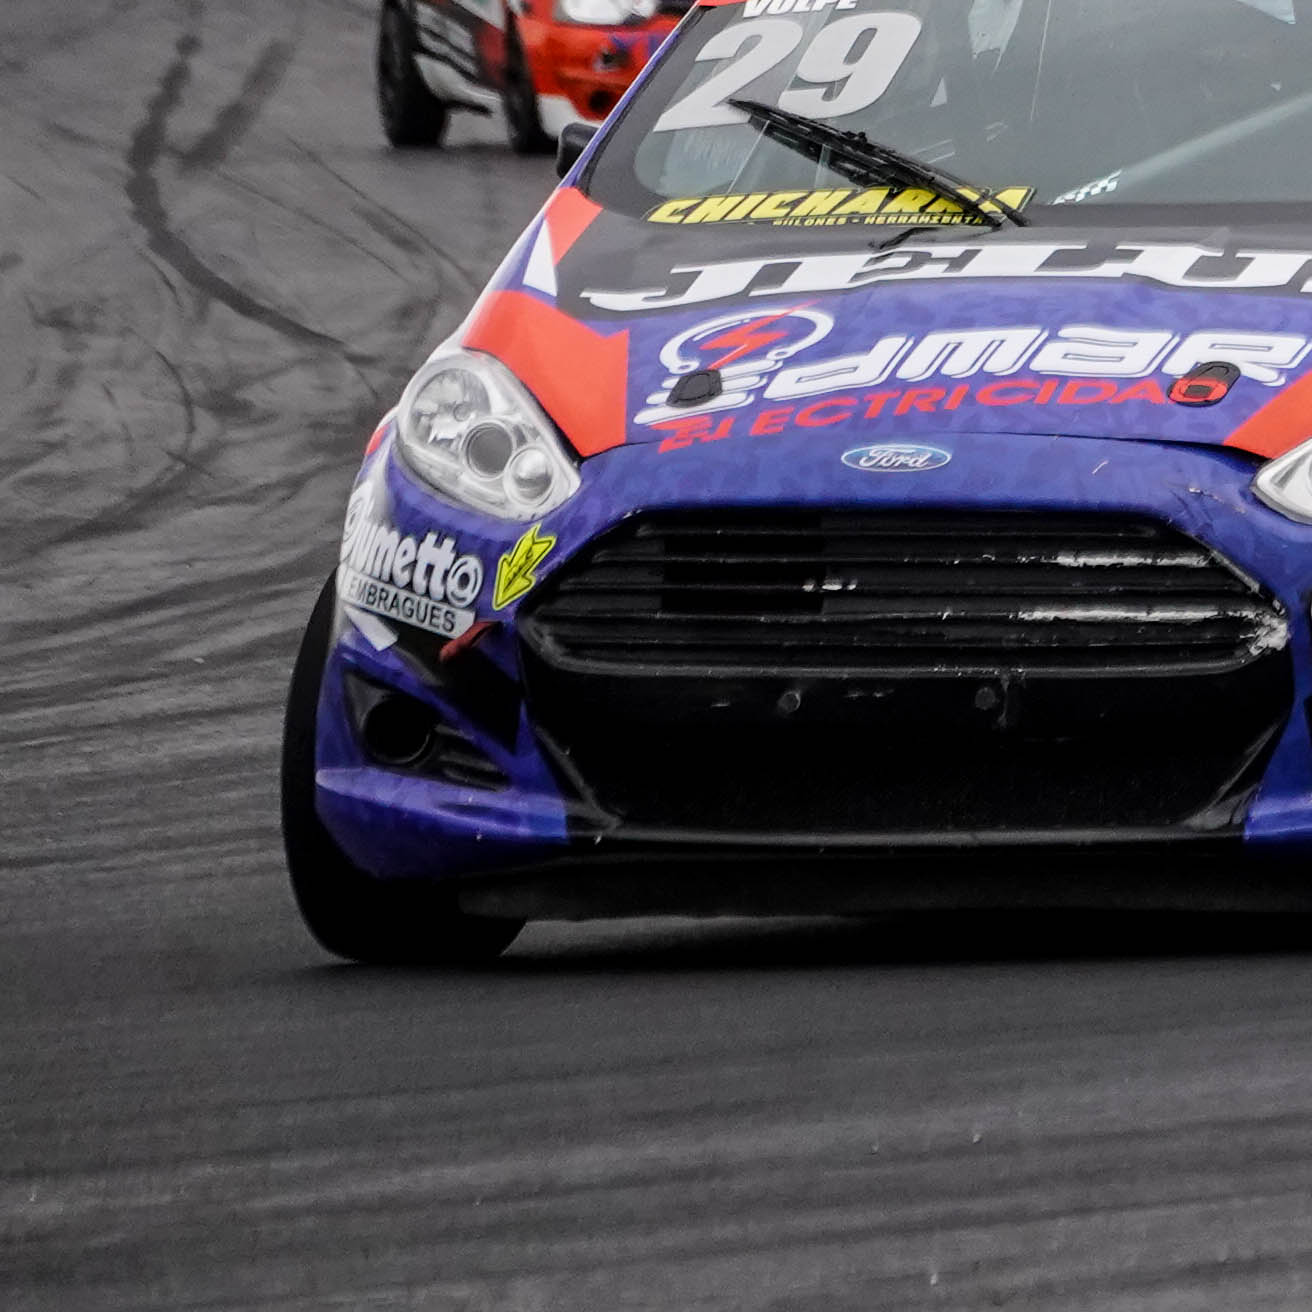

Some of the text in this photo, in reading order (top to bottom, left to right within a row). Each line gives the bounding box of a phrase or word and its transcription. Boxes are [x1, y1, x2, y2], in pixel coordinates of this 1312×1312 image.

[653, 11, 922, 133] 29
[860, 446, 931, 470] Ford
[350, 572, 457, 634] EMBRAGUES
